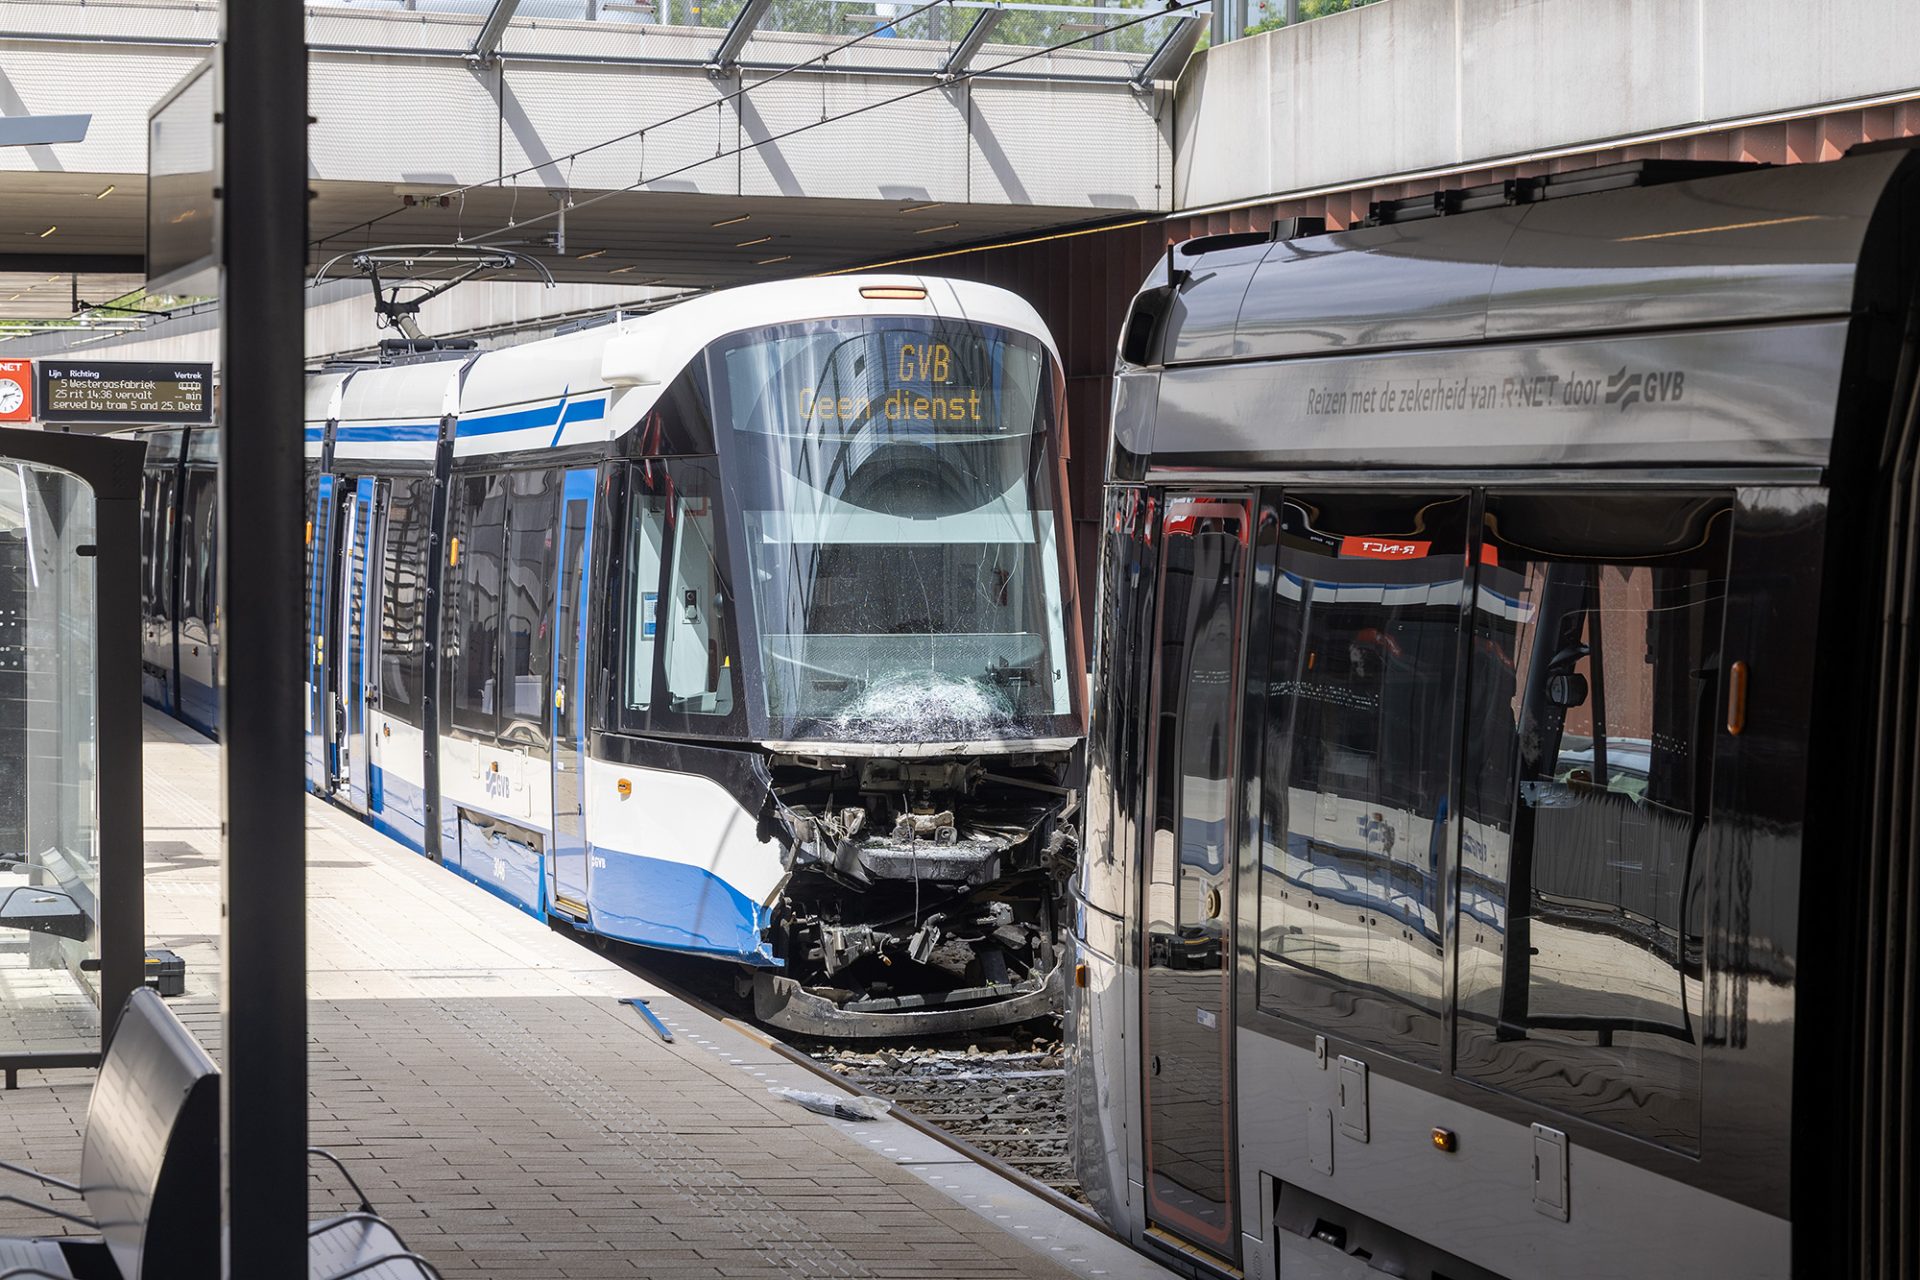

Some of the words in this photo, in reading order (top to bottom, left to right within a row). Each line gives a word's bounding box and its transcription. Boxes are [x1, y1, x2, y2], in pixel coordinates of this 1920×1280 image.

[48, 369, 62, 378] Lijn
[69, 369, 100, 379] Richting
[174, 371, 202, 379] Vertrek
[898, 344, 950, 382] GVB
[55, 389, 68, 399] 25
[69, 390, 84, 399] rit
[87, 390, 113, 399] 14:36
[115, 390, 153, 400] vervalt
[185, 391, 202, 400] min
[61, 379, 68, 388] 5
[69, 379, 156, 390] Westergasfabriek
[1306, 387, 1347, 415] Reizen
[1349, 386, 1377, 414] met
[1379, 381, 1396, 413] de
[1400, 377, 1469, 412] zekerheid
[1471, 383, 1497, 410] van
[1563, 371, 1602, 406] door
[1644, 371, 1685, 403] GVB
[53, 400, 88, 409] served
[90, 400, 103, 410] by
[106, 400, 128, 410] tram
[130, 400, 137, 410] 5
[140, 401, 158, 410] and
[885, 387, 981, 420] dienst
[497, 774, 510, 799] GVB
